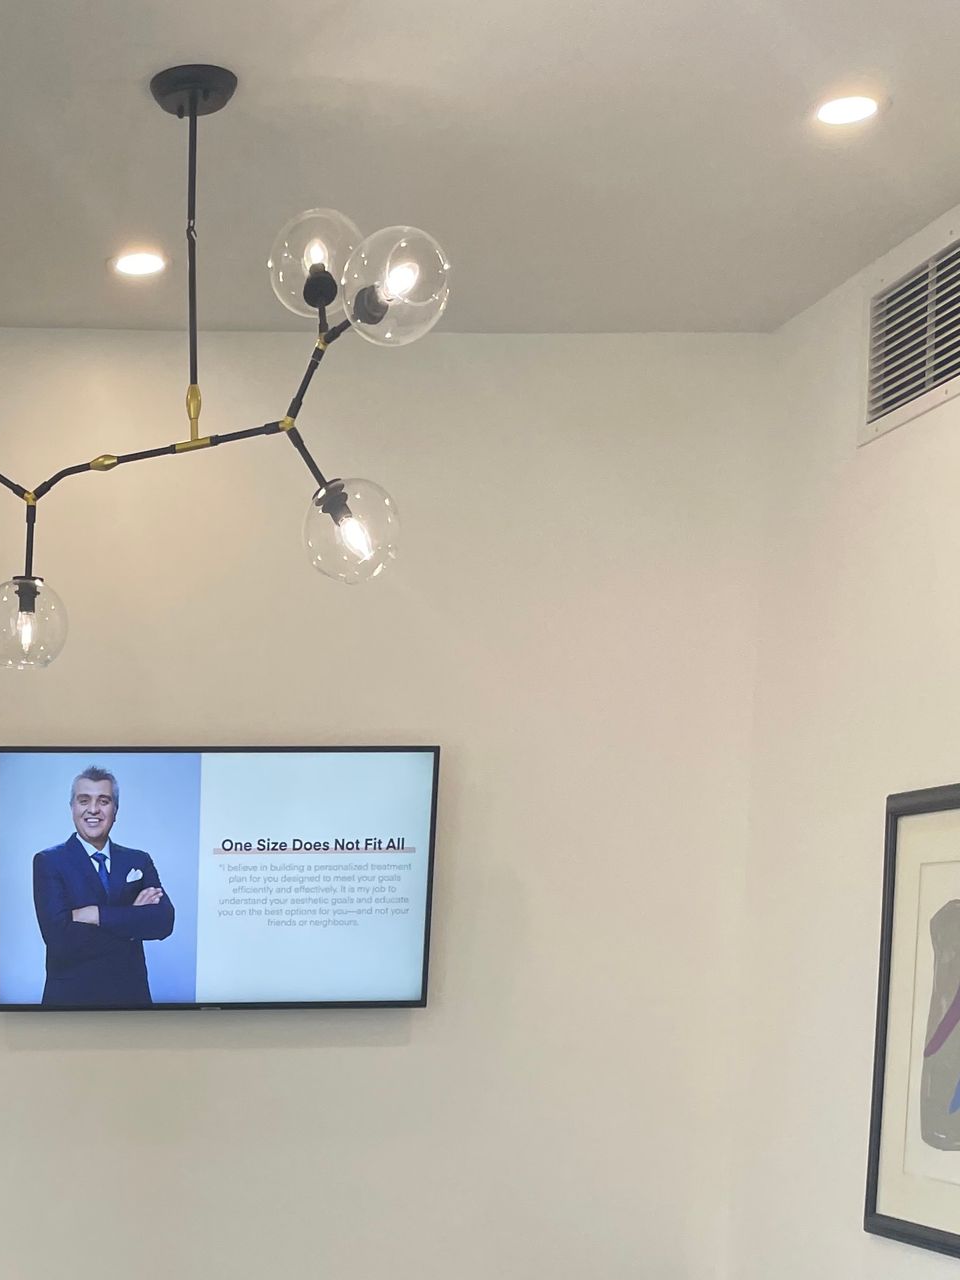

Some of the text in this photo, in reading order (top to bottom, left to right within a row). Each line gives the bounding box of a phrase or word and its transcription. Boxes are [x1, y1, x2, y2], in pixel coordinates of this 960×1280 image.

[221, 838, 405, 851] One Size Does Not Fit All
[270, 864, 304, 873] building
[314, 864, 368, 873] personalized
[229, 875, 247, 885] plan
[281, 875, 320, 884] designed
[377, 875, 401, 883] goals
[232, 886, 273, 895] efficiently
[372, 885, 386, 894] job
[331, 896, 354, 906] goals
[285, 908, 317, 917] options
